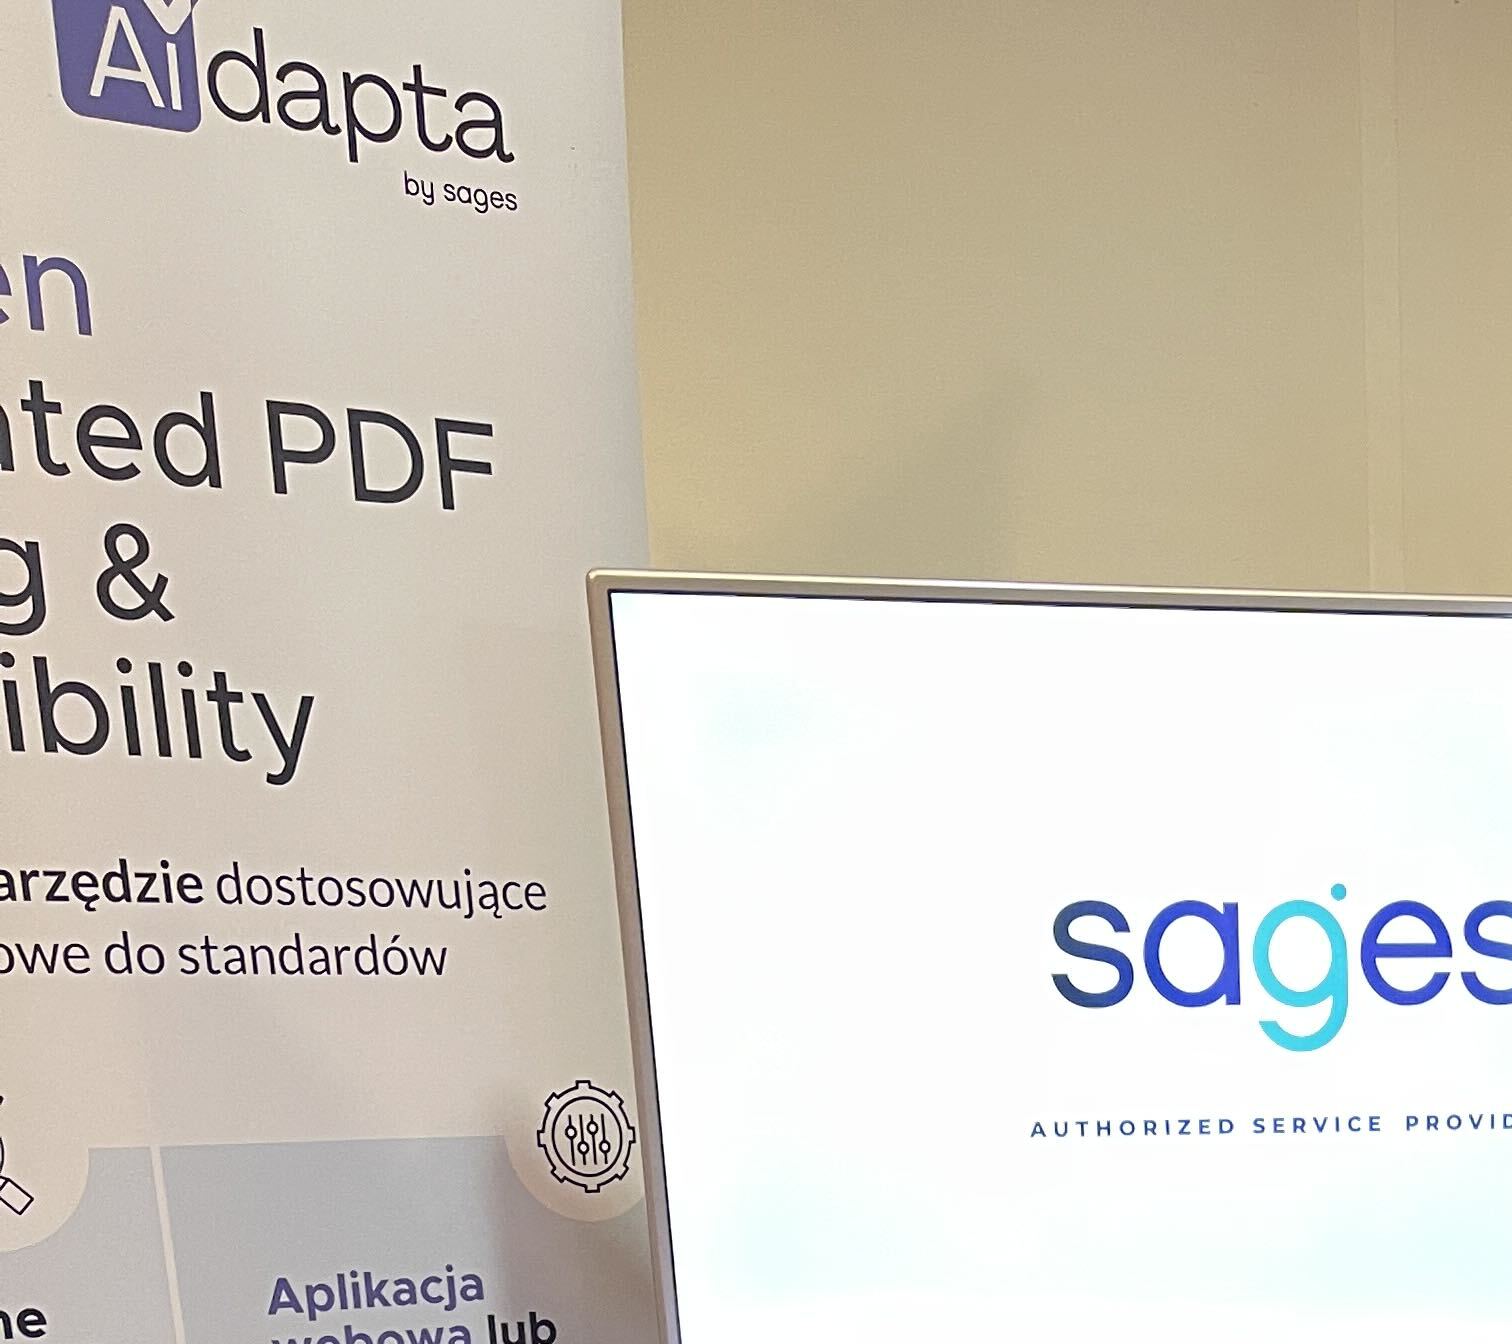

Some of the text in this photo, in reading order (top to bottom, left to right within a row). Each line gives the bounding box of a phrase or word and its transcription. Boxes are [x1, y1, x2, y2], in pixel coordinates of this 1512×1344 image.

[403, 170, 518, 214] by sages
[0, 252, 92, 336] n
[0, 378, 494, 510] ted PDF
[96, 522, 175, 622] &
[0, 651, 314, 786] ibility
[215, 861, 548, 920] dostosowujące
[104, 931, 165, 975] do
[179, 932, 448, 977] standardów
[1030, 1118, 1235, 1138] AUTHORIZED
[1252, 1116, 1382, 1135] SERVICE
[267, 1265, 486, 1322] Aplikacja
